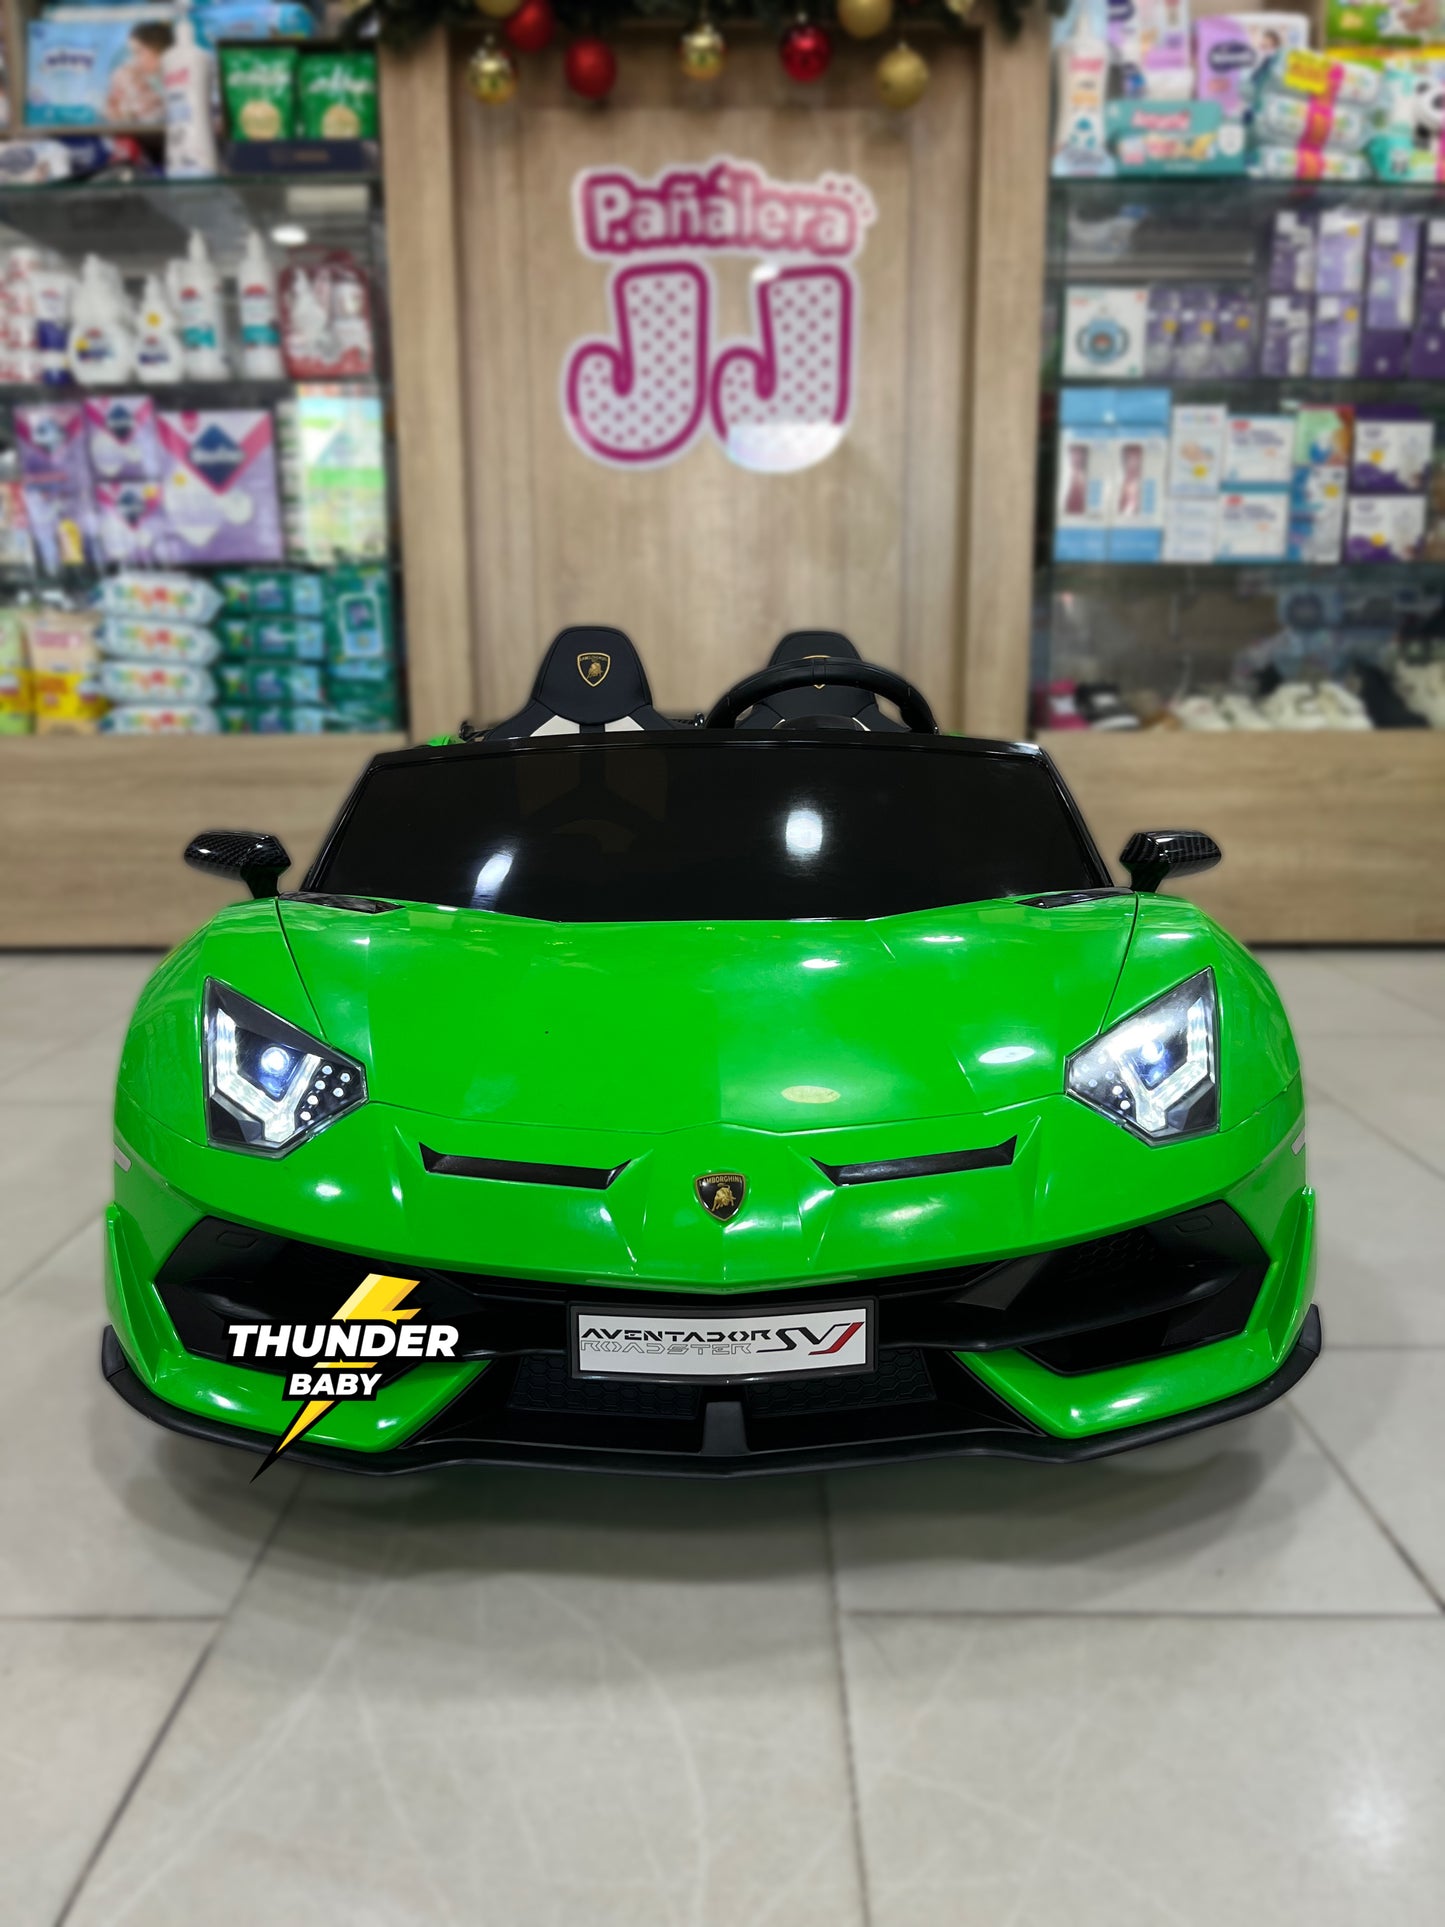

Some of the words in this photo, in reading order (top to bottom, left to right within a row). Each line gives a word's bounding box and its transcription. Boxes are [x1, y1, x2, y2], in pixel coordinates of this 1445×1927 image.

[566, 260, 853, 473] JJ
[581, 1328, 772, 1343] AVENTADOR
[756, 1321, 865, 1356] SVJ
[581, 1340, 752, 1356] ROADSTER
